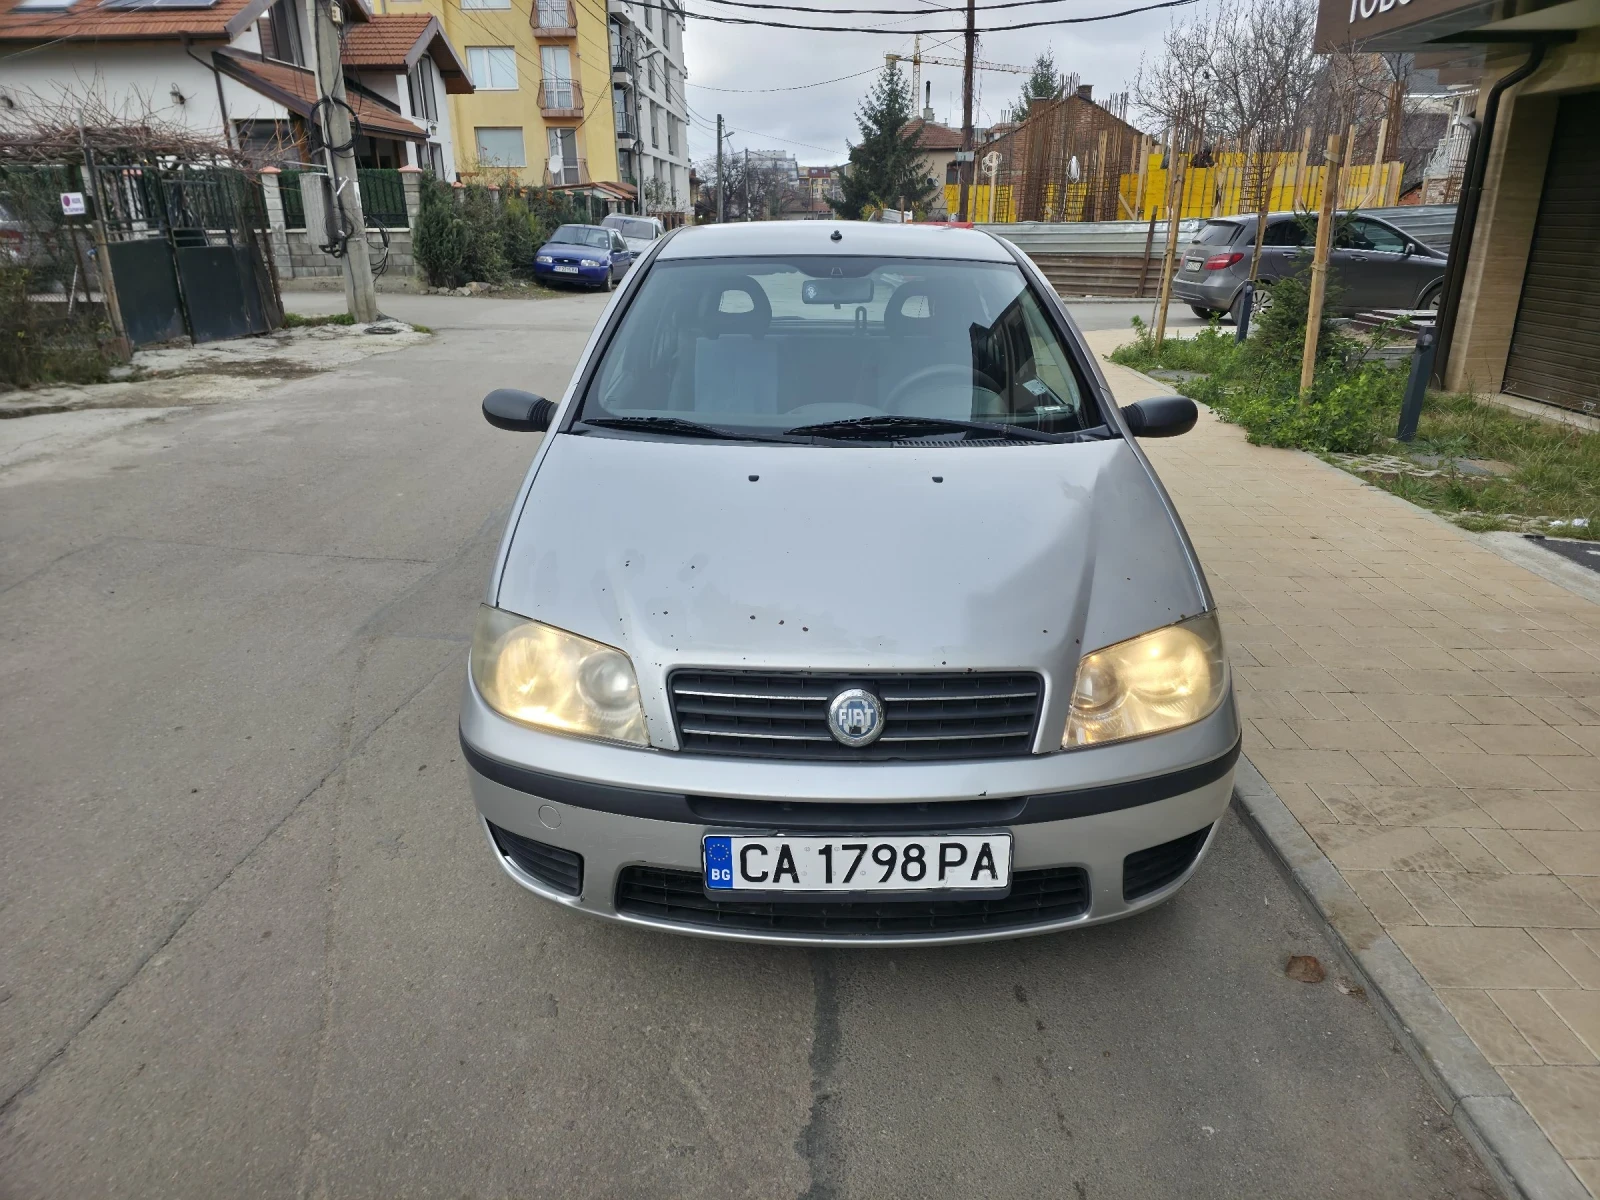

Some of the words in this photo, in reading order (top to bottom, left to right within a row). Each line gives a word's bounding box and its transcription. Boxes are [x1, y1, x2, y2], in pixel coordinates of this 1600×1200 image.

[838, 708, 874, 726] FIAT
[739, 843, 800, 884] CA
[818, 843, 927, 884] 1798
[938, 842, 999, 882] PA
[711, 868, 731, 881] BG
